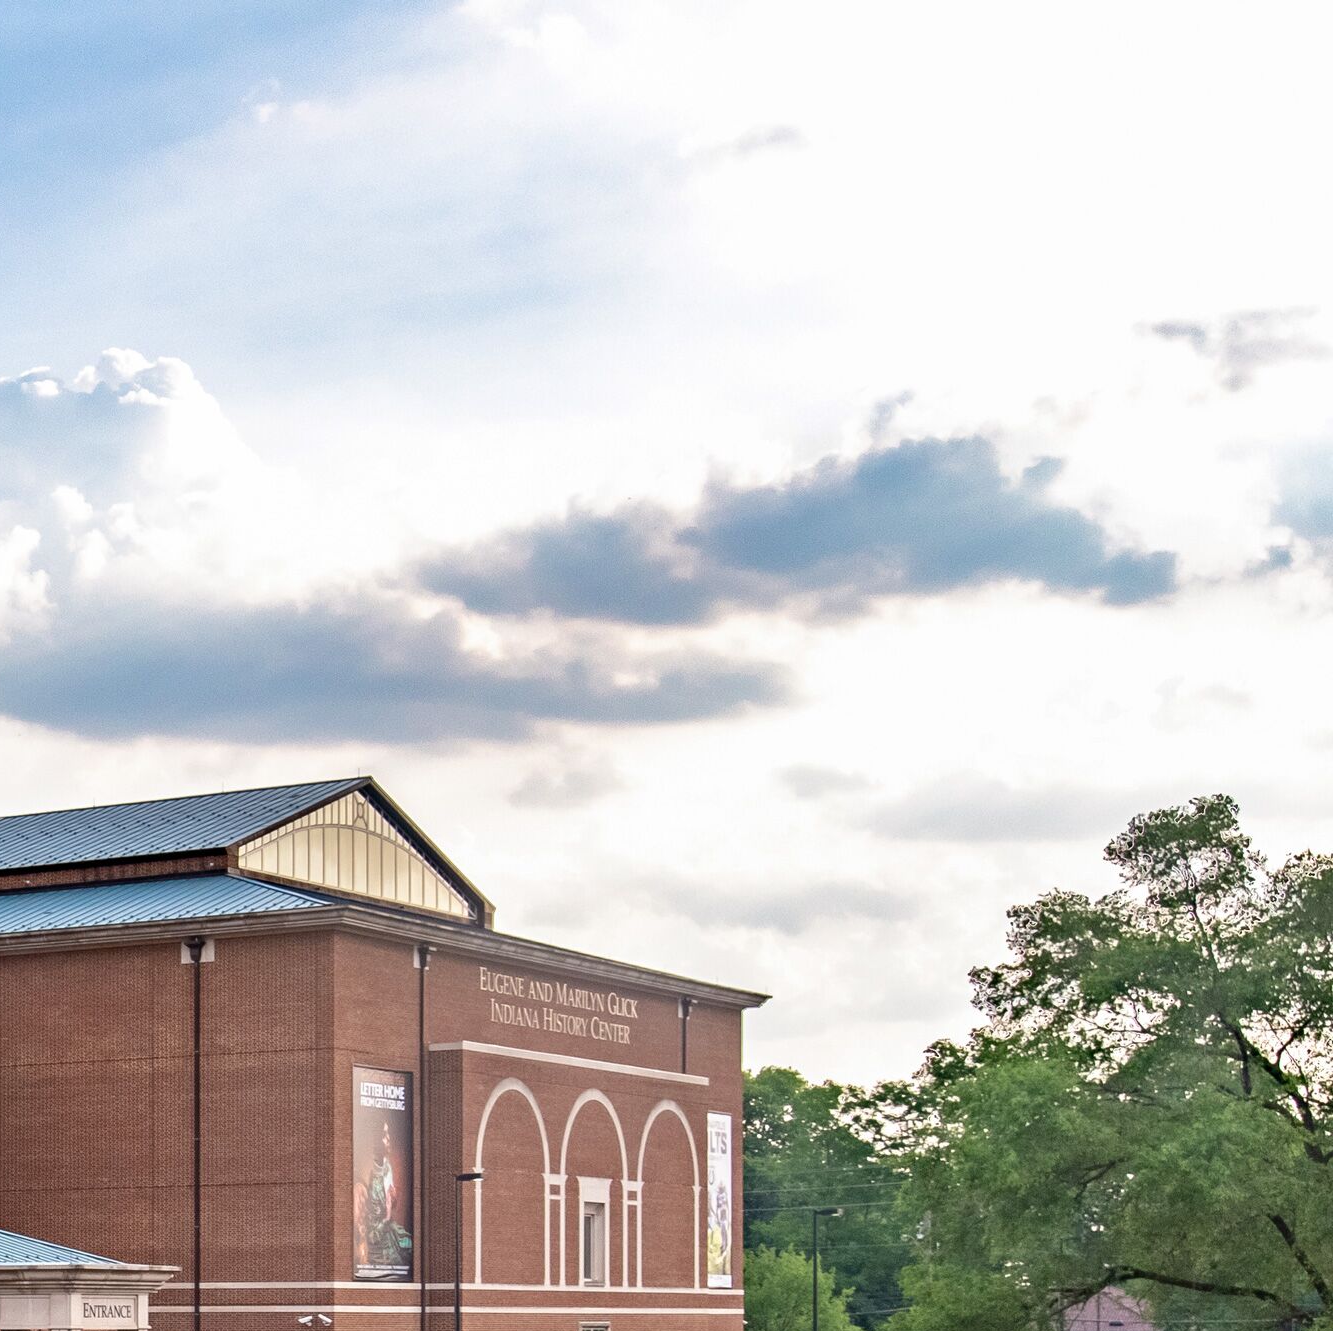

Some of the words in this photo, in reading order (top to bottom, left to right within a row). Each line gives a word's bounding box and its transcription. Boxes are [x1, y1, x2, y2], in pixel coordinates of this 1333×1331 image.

[479, 967, 524, 997] EUGENE
[528, 980, 553, 1003] AND
[556, 982, 605, 1012] MARILYN
[607, 992, 638, 1018] GLICK
[490, 998, 540, 1029] INDIANA
[543, 1007, 588, 1037] HISTORY
[591, 1016, 630, 1044] CENTER
[360, 1081, 383, 1097] LETTER
[384, 1085, 405, 1099] HOME
[83, 1303, 131, 1318] ENTRANCE
